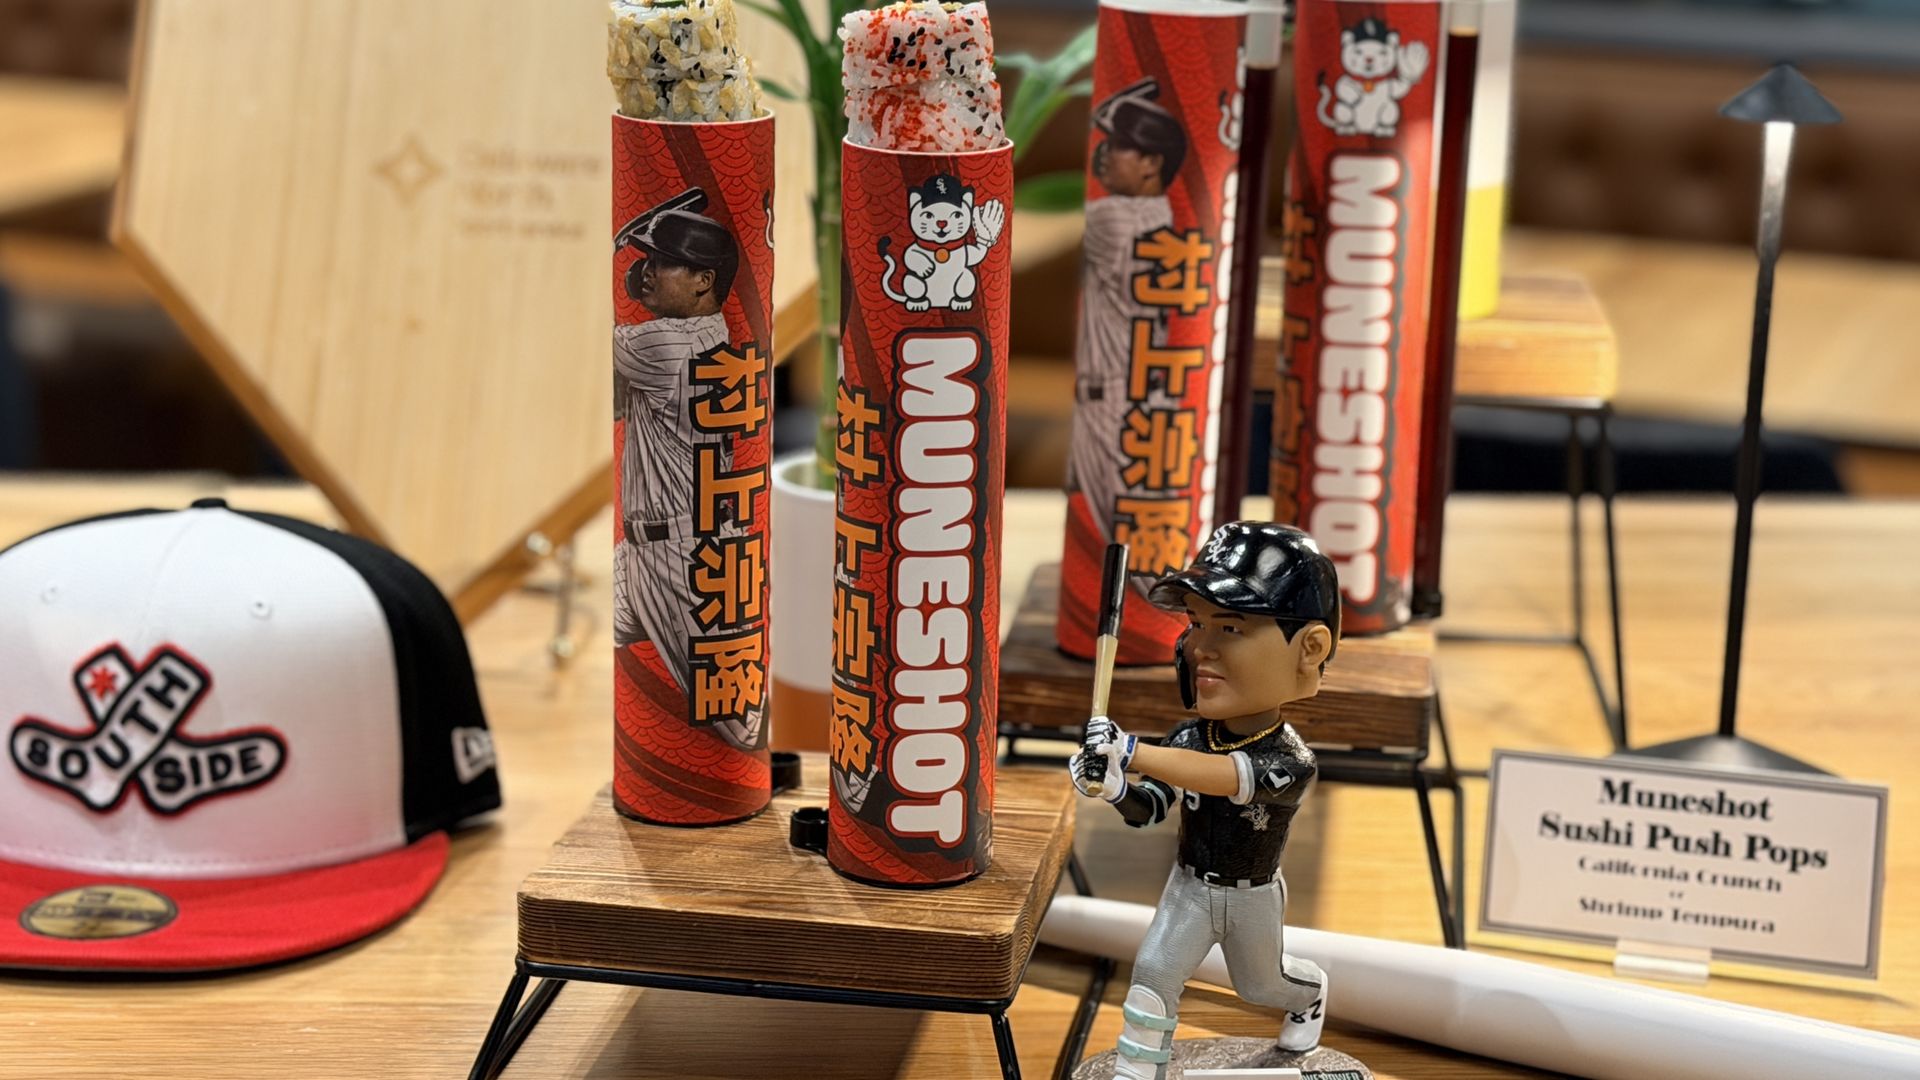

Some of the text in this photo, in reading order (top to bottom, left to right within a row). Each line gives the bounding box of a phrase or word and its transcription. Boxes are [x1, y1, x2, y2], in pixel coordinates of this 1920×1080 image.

[1115, 229, 1212, 577] 村上宗隆
[1311, 155, 1399, 603] MUNESHOT
[692, 343, 768, 722] 村上宗隆
[890, 337, 977, 843] MUNESHOT
[27, 668, 190, 773] SOUTH
[153, 744, 262, 793] SIDE
[1599, 777, 1773, 822] Muneshot
[1539, 812, 1829, 874] Sushi Push Pops
[1579, 856, 1782, 893] California Crunch
[1579, 897, 1776, 933] Shrimp Tempura
